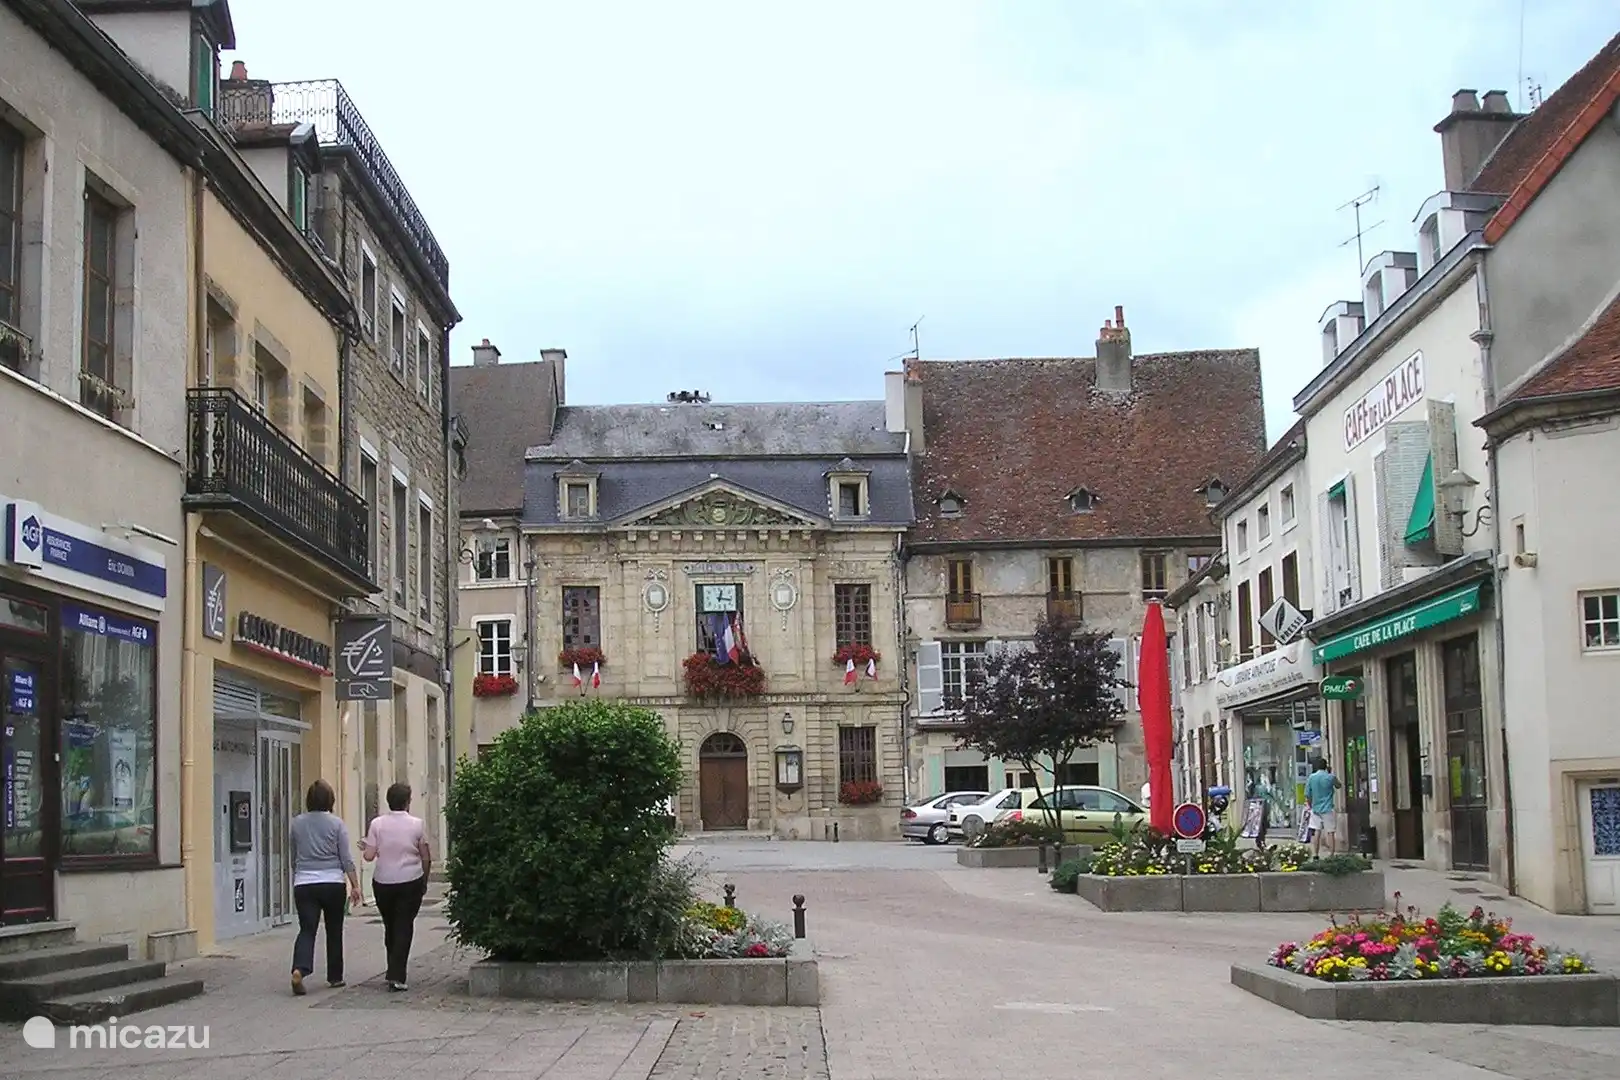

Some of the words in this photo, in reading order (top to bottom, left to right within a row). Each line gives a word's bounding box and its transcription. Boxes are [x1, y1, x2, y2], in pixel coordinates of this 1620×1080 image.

[1345, 399, 1368, 448] CAFÉ
[1385, 355, 1422, 416] PLACE
[23, 525, 42, 542] AGF
[1280, 616, 1304, 641] PRESSE
[1354, 632, 1372, 649] CAFE
[1372, 628, 1381, 643] DE
[1383, 624, 1392, 640] LA
[1394, 616, 1416, 637] PLACE
[1323, 684, 1345, 694] PMU
